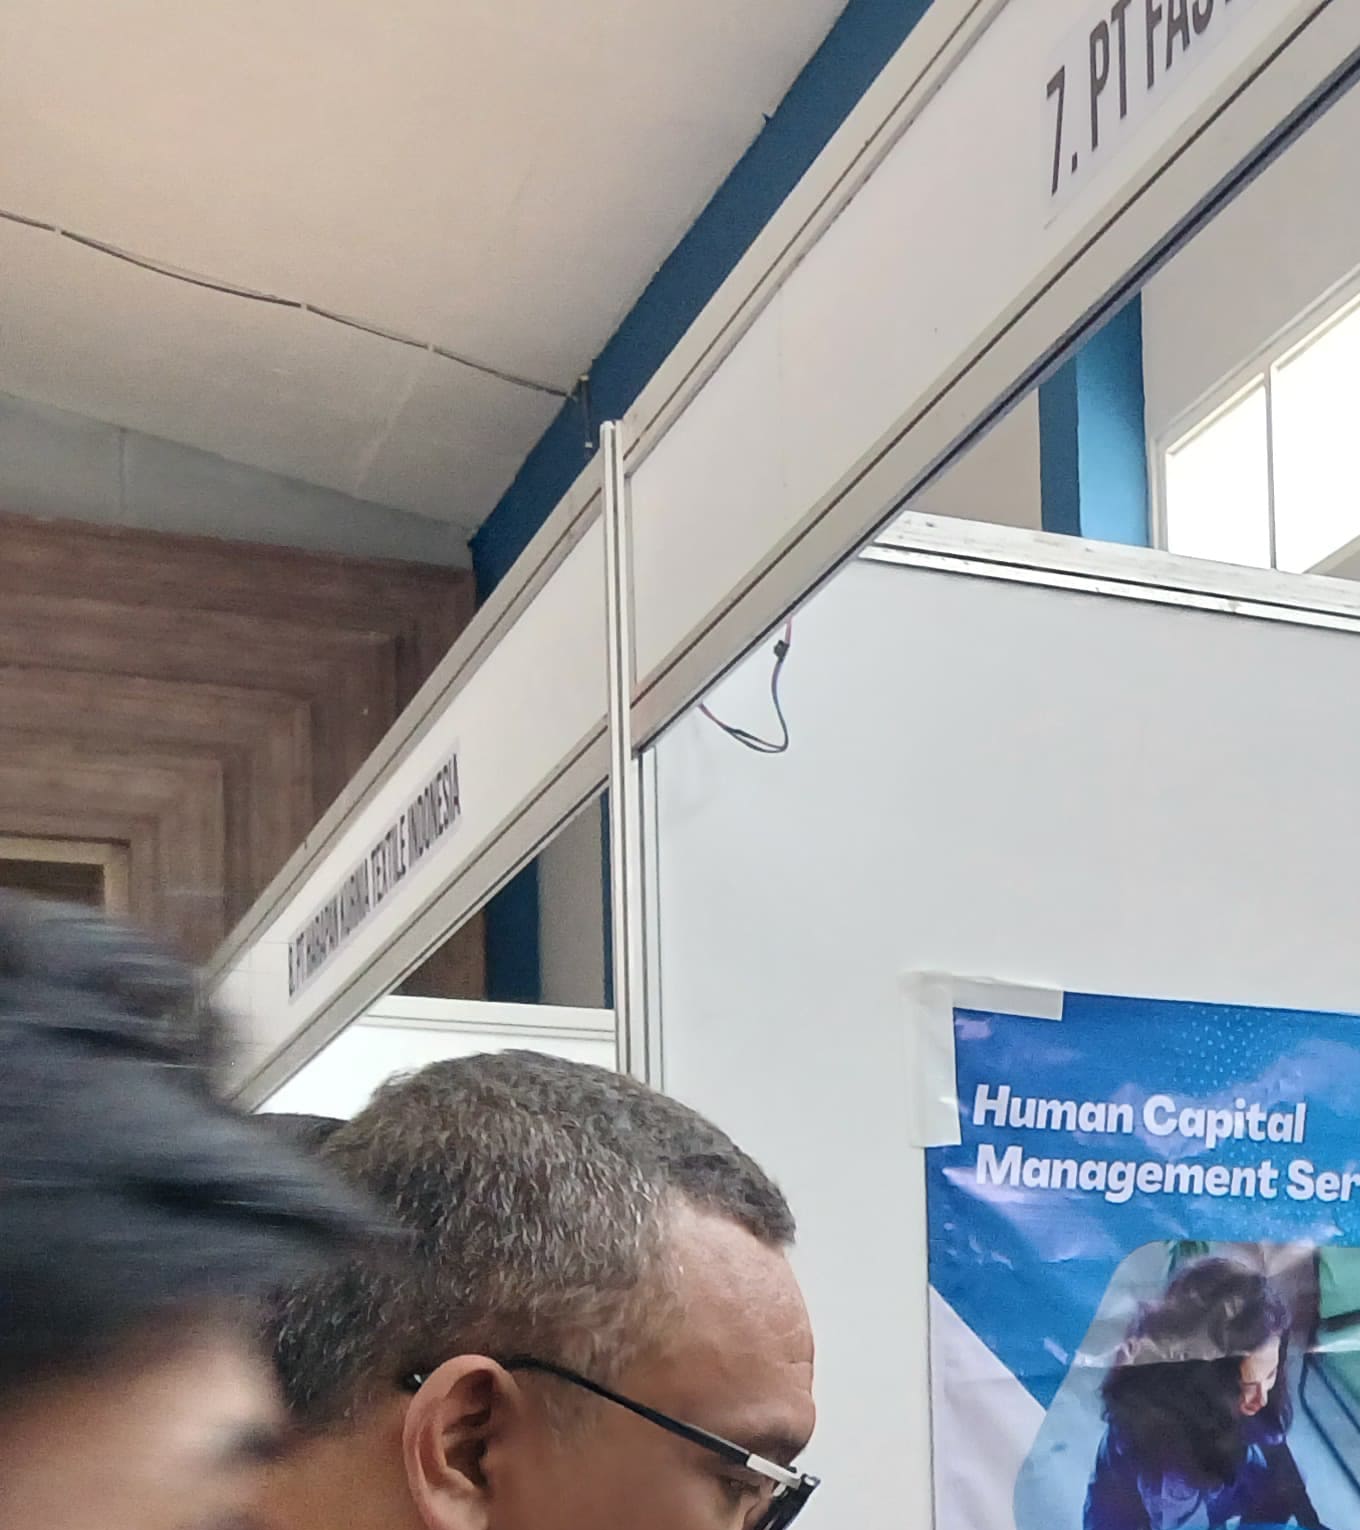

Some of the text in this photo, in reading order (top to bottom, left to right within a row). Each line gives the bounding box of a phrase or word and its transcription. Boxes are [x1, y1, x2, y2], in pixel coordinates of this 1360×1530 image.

[1046, 65, 1078, 196] 7.
[1089, 0, 1132, 152] PT
[371, 813, 406, 910] TEXTILE
[407, 752, 461, 869] INDONESIA
[973, 1083, 1307, 1149] Human Capital
[976, 1143, 1278, 1204] Management
